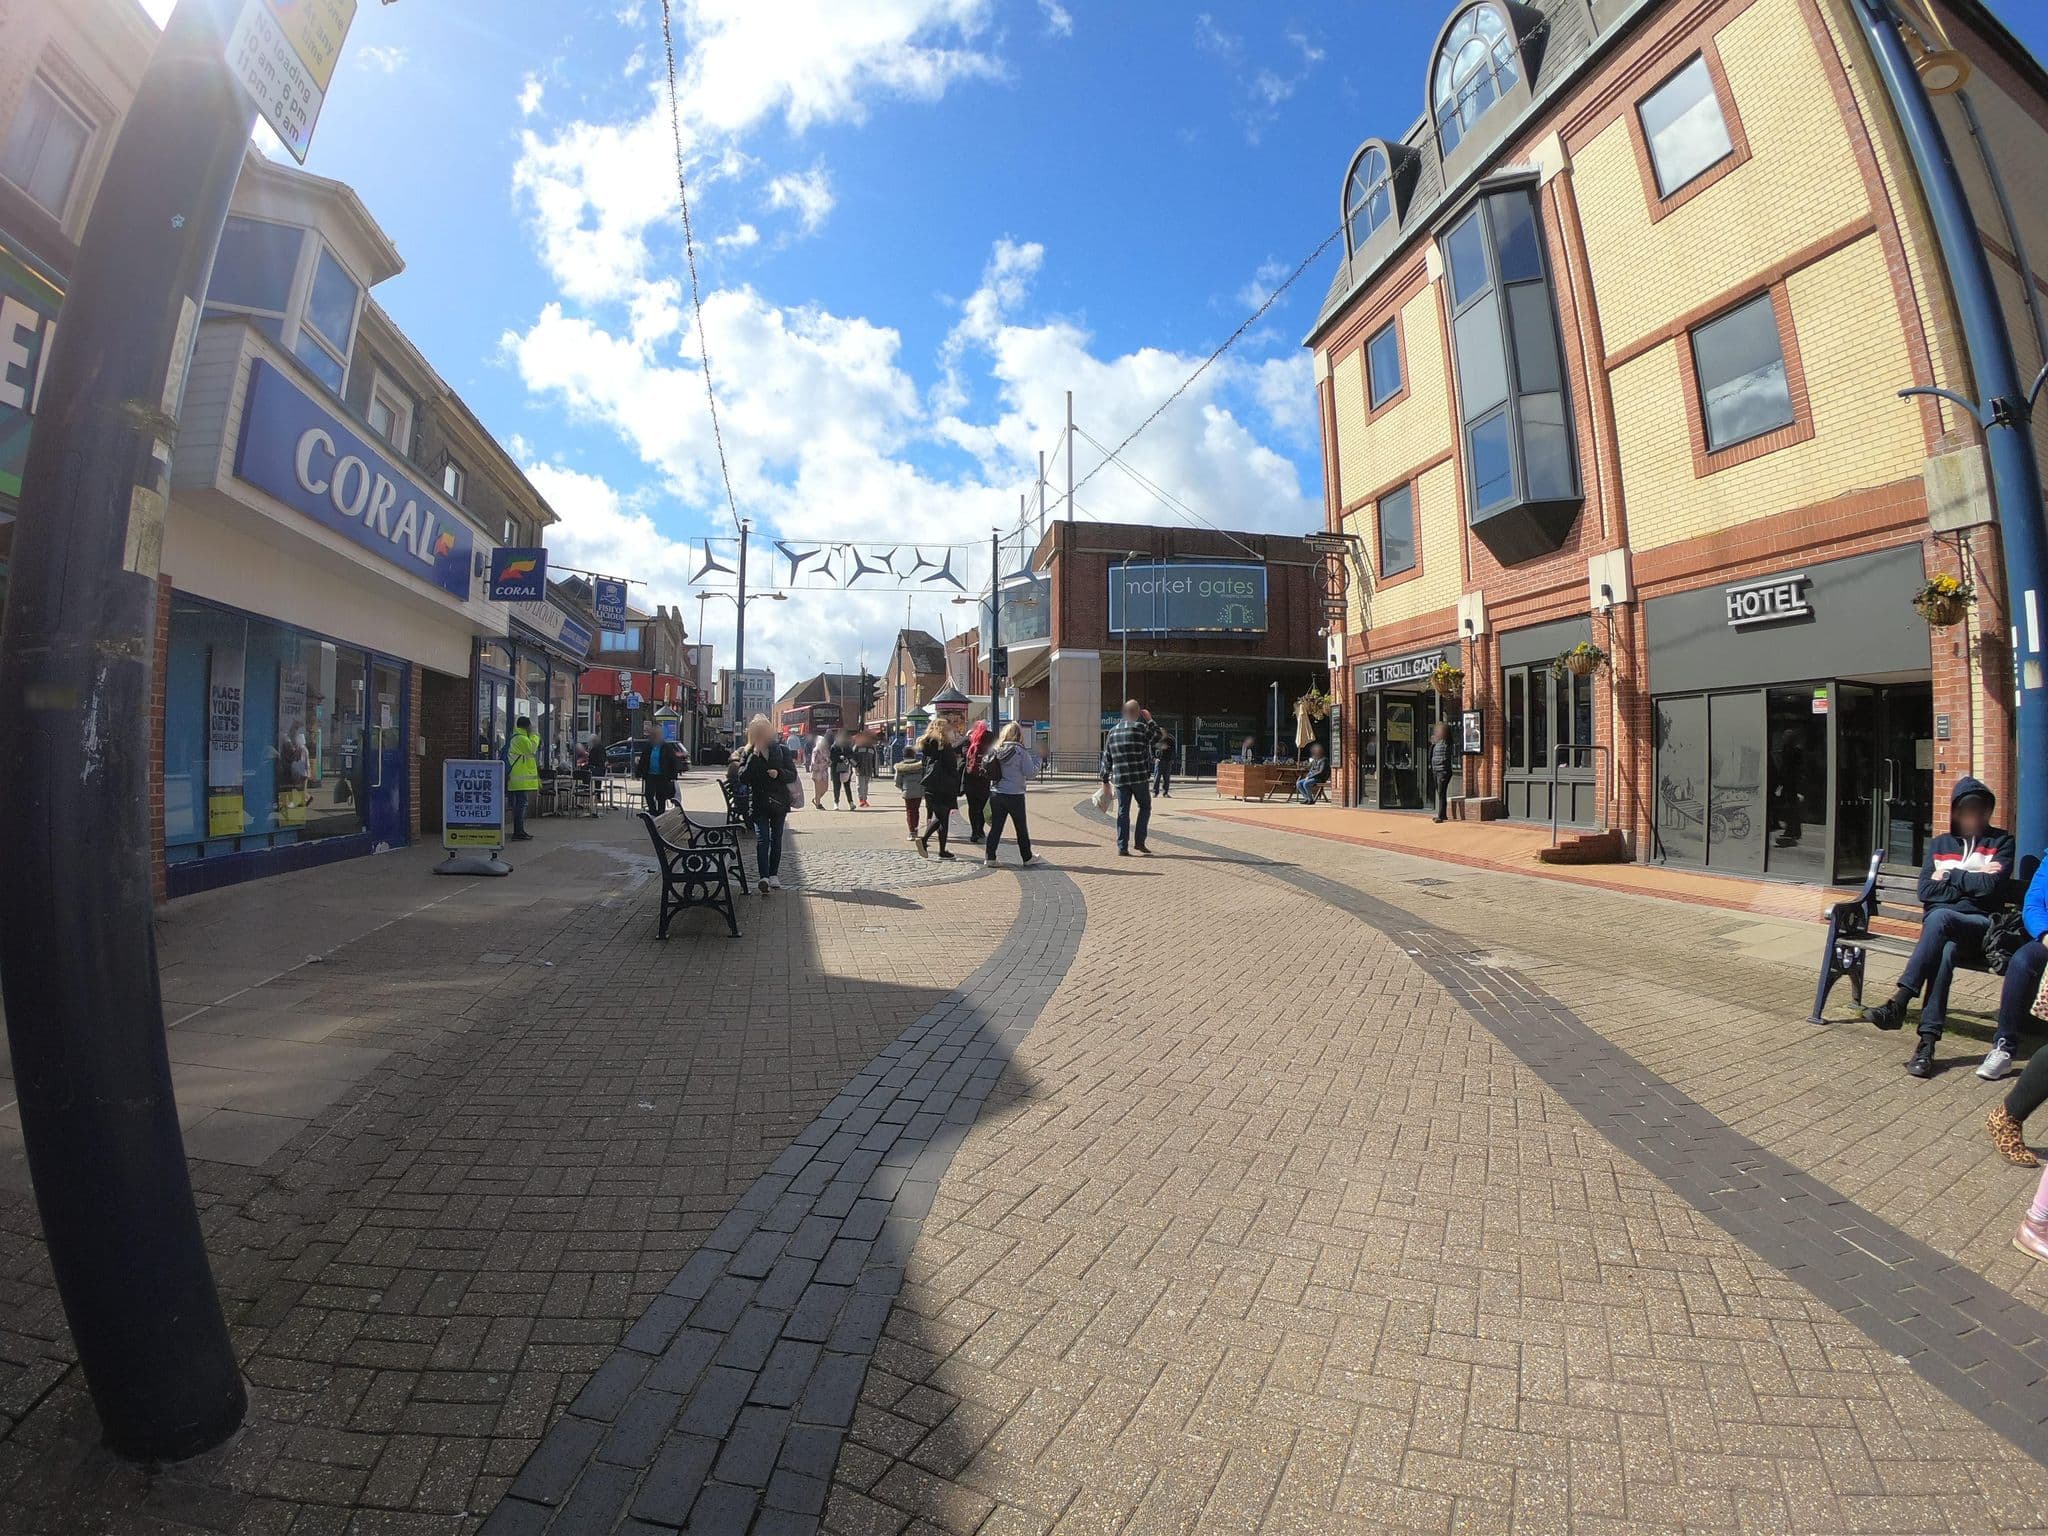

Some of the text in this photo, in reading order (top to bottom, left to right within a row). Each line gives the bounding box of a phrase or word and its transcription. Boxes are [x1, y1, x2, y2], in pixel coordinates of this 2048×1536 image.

[301, 25, 324, 66] time
[316, 27, 335, 57] any
[255, 11, 312, 104] No loading
[243, 27, 258, 53] 10
[257, 51, 276, 81] am
[282, 83, 292, 101] 6
[289, 98, 307, 126] pm
[237, 47, 250, 72] 11
[247, 70, 268, 99] pm
[274, 101, 284, 119] 6
[282, 114, 300, 142] am
[295, 428, 436, 567] CORAL
[495, 586, 537, 596] CORAL
[1126, 576, 1254, 598] market gates
[1726, 583, 1807, 619] HOTEL
[596, 610, 625, 622] LICIOUS
[1362, 655, 1441, 685] THE TROLL CART
[212, 686, 240, 701] PLACE
[212, 700, 240, 716] YOUR
[212, 716, 240, 733] BETS
[1201, 721, 1238, 729] Poundland
[219, 742, 238, 752] HELP
[454, 769, 492, 780] PLACE
[455, 779, 492, 791] YOUR
[454, 791, 492, 804] BETS
[455, 810, 492, 818] TO HELP
